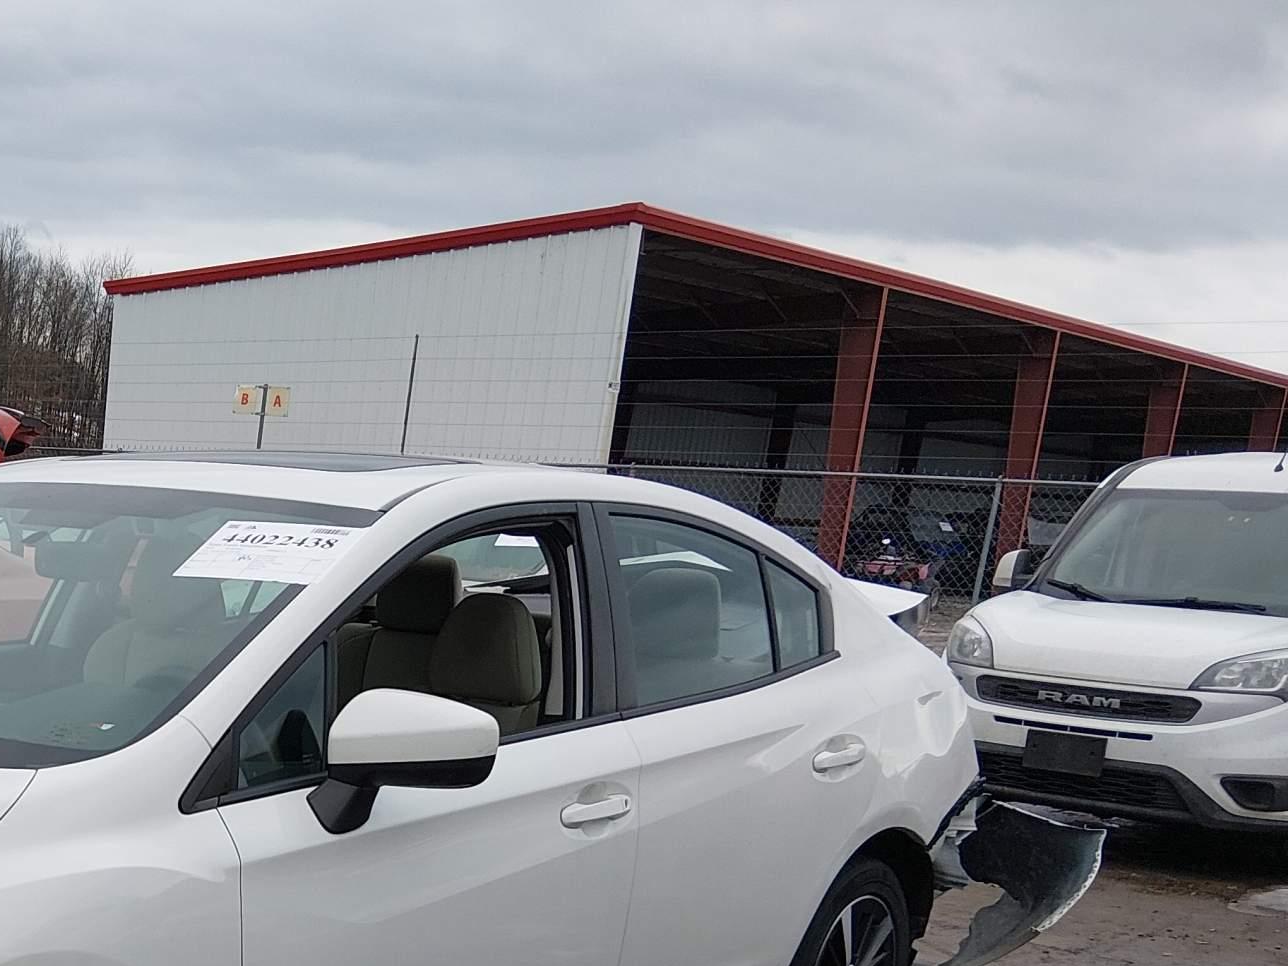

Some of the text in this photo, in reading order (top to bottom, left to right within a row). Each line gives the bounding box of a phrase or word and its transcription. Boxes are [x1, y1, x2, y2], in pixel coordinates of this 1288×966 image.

[240, 393, 249, 405] B
[273, 395, 282, 407] A
[222, 533, 339, 549] 44022438
[1037, 690, 1121, 709] RAM
